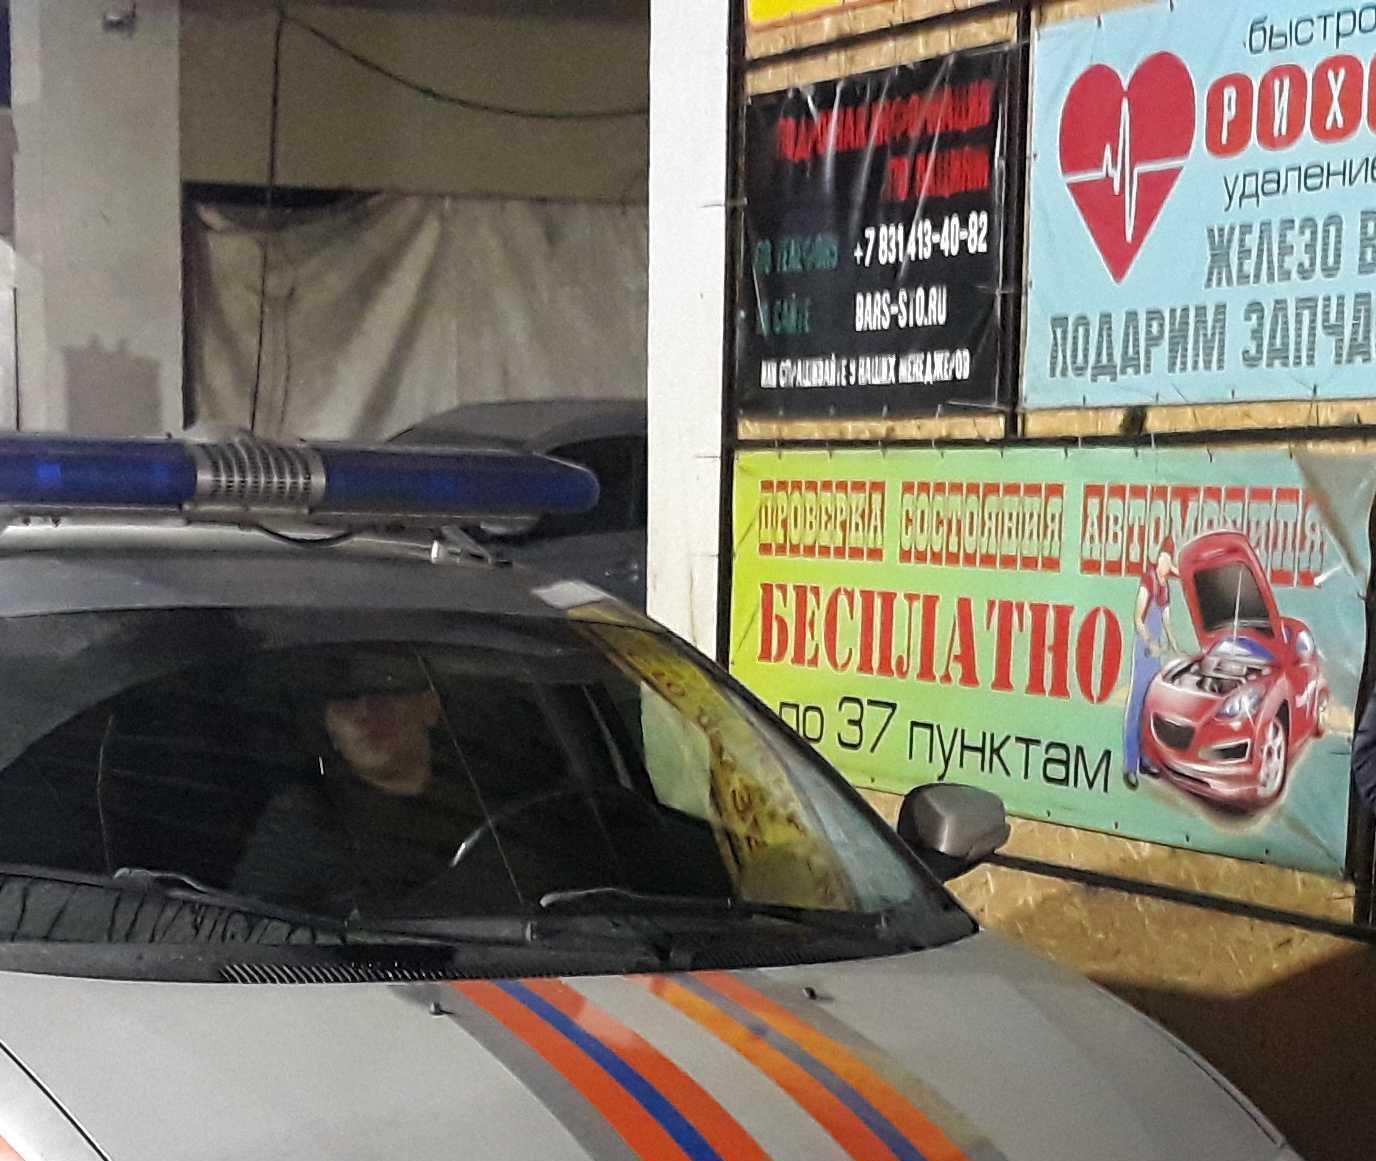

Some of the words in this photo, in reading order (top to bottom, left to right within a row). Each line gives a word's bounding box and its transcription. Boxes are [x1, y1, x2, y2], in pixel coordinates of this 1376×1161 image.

[854, 227, 875, 267] +7
[878, 223, 904, 264] 831
[907, 211, 989, 261] 413-40-82
[1204, 211, 1344, 289] ЖЕЛЕЗО
[1049, 303, 1227, 382] ПОДАРИМ
[758, 480, 886, 561] ПРОВЕРКА
[898, 481, 1065, 573] СОСТОЯНИЯ
[757, 582, 1123, 704] БЕСПЛАТНО
[778, 700, 824, 744] по
[837, 696, 898, 754] 37
[909, 719, 1112, 793] пунктам
